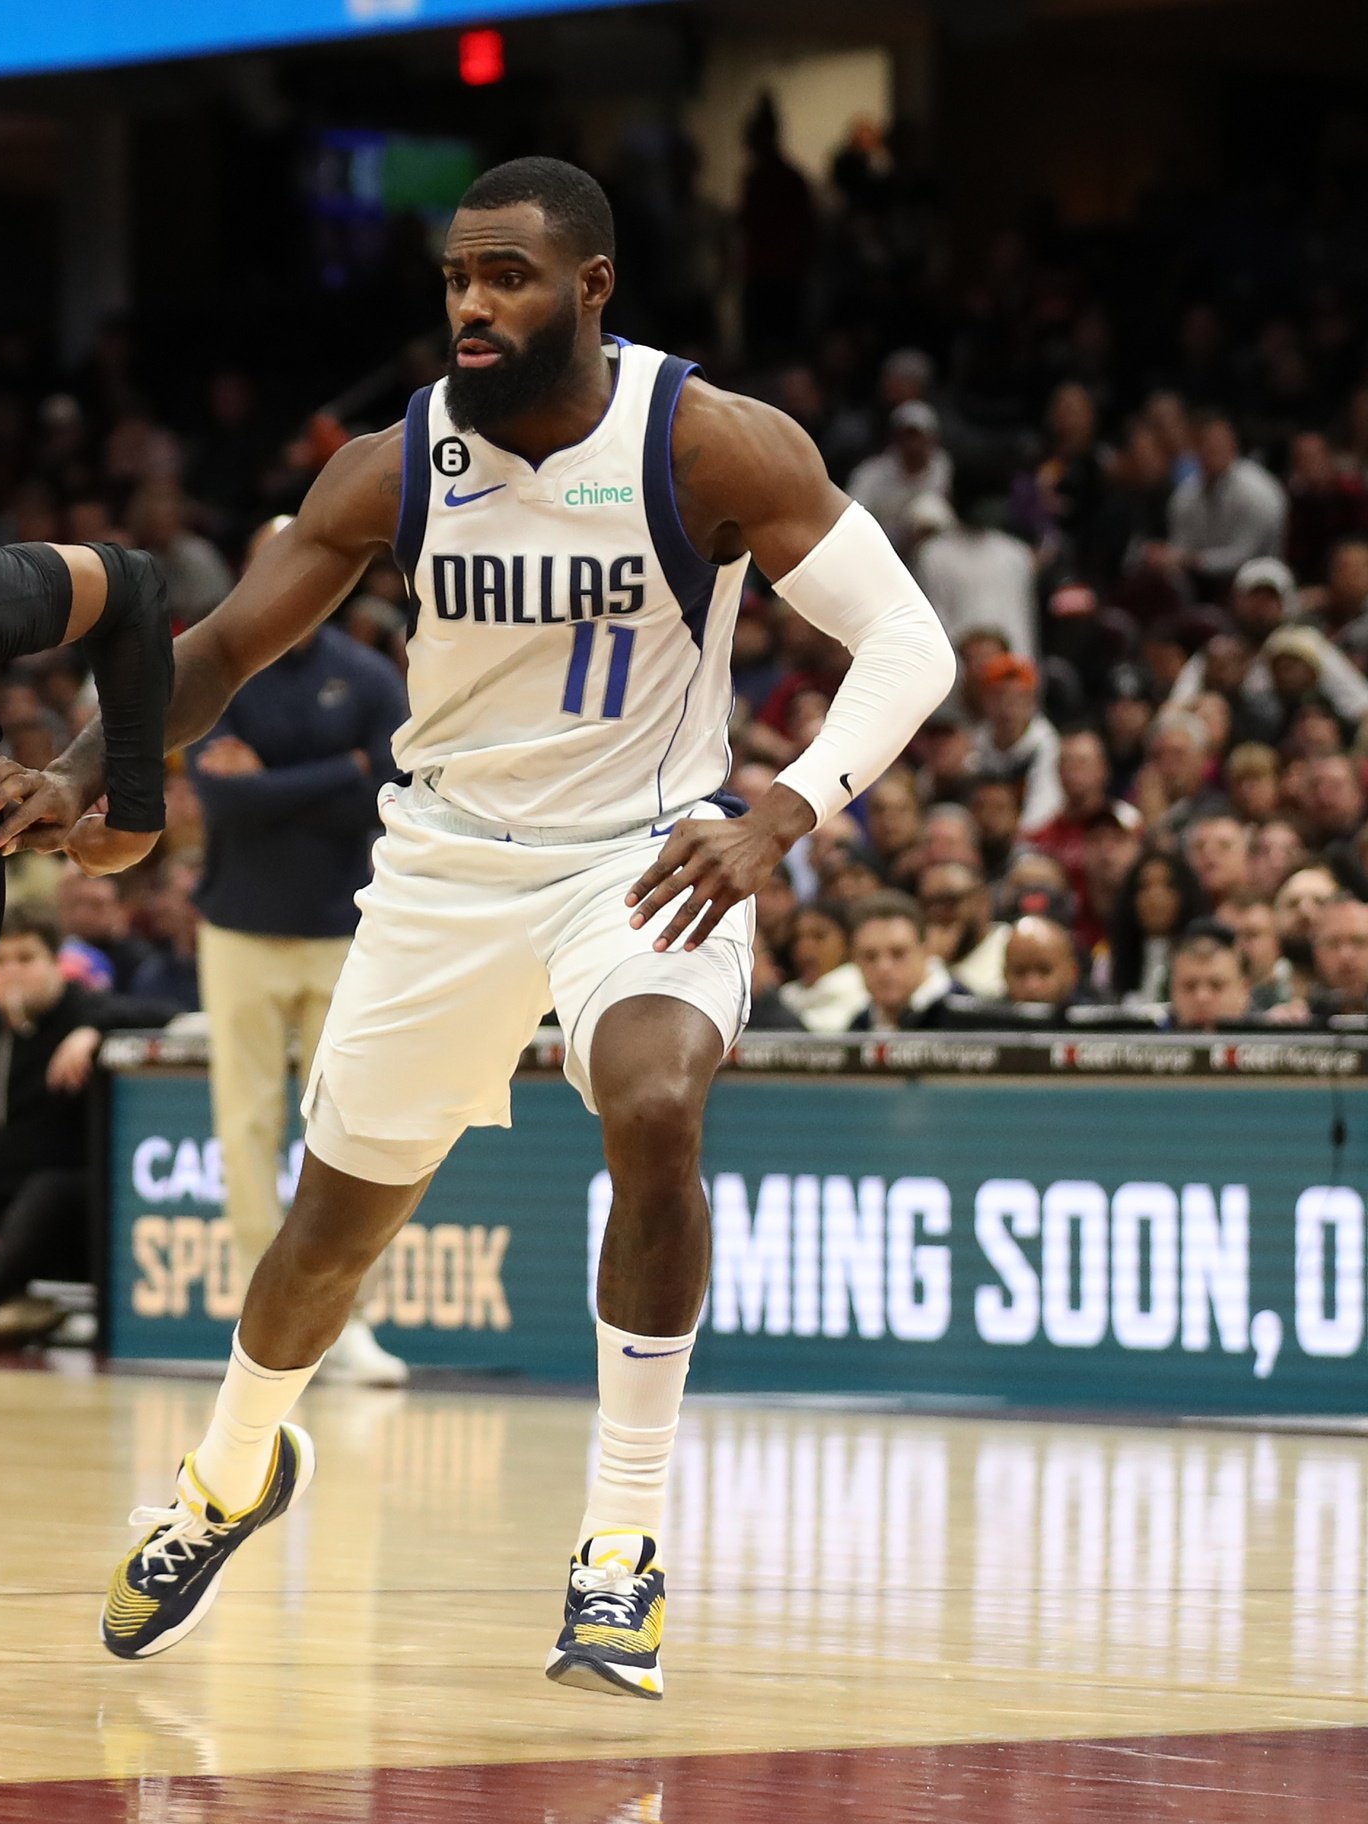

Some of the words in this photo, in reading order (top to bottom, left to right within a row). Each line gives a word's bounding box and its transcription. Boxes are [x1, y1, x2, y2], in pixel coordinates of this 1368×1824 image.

[442, 442, 463, 471] 6
[565, 482, 633, 505] chime
[432, 554, 646, 626] DALLAS
[560, 620, 637, 720] 11
[133, 1215, 512, 1331] SPOOOK
[587, 1168, 951, 1341] MING
